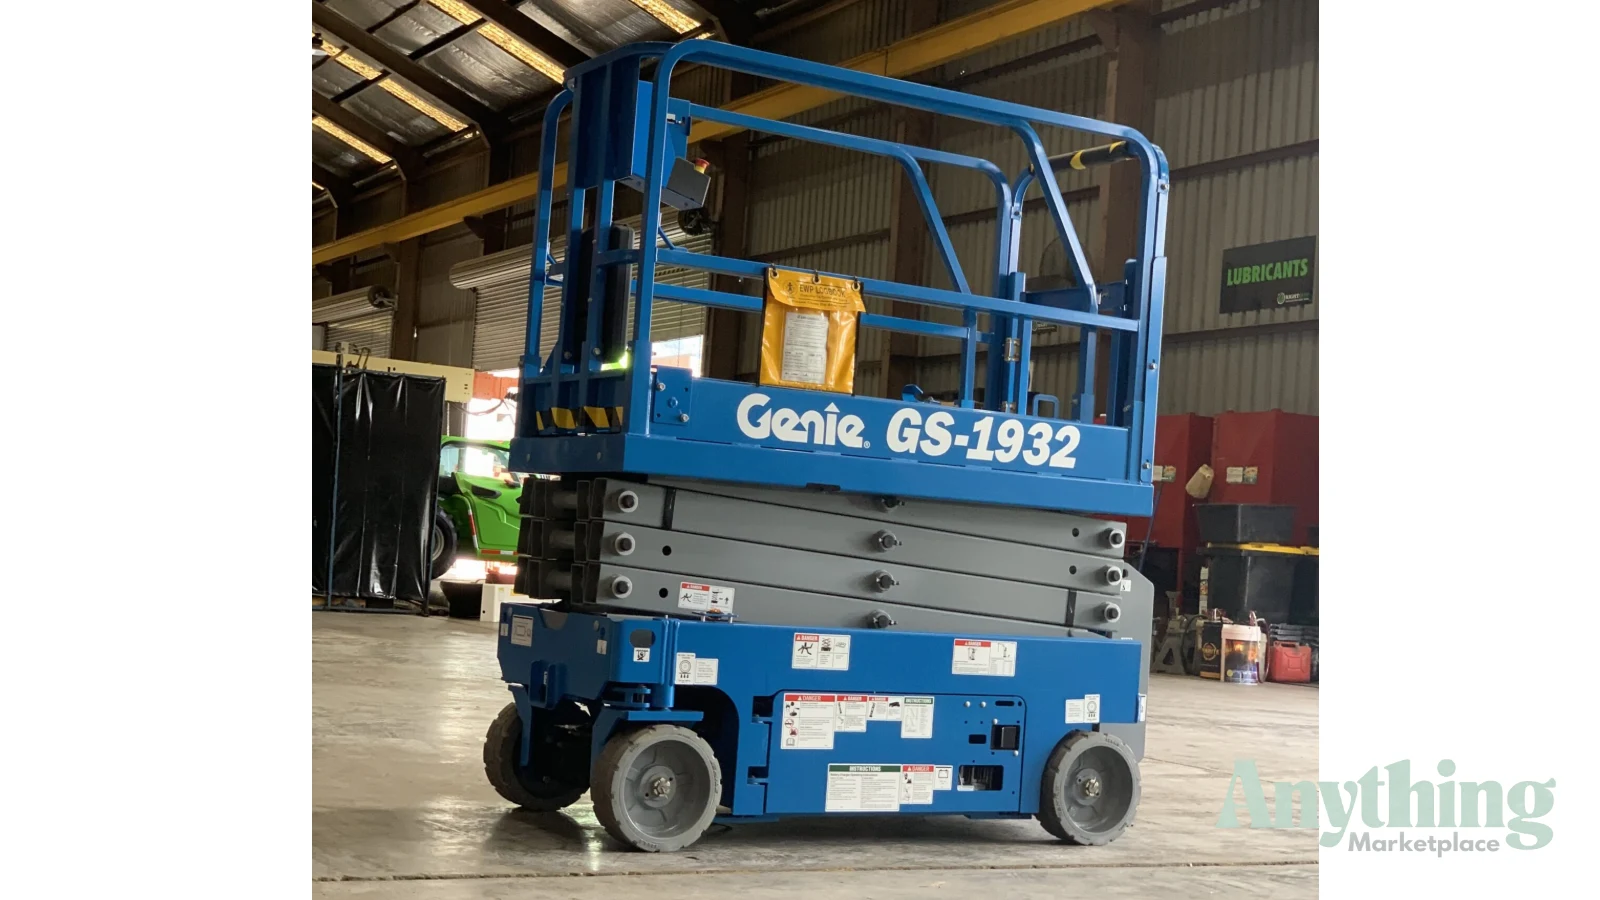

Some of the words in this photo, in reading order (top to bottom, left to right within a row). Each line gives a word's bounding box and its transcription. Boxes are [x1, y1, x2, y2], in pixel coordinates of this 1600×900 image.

[1227, 258, 1308, 287] LUBRICANTS
[800, 284, 814, 293] EWP
[737, 393, 865, 449] Genie
[887, 408, 1080, 469] GS-1932
